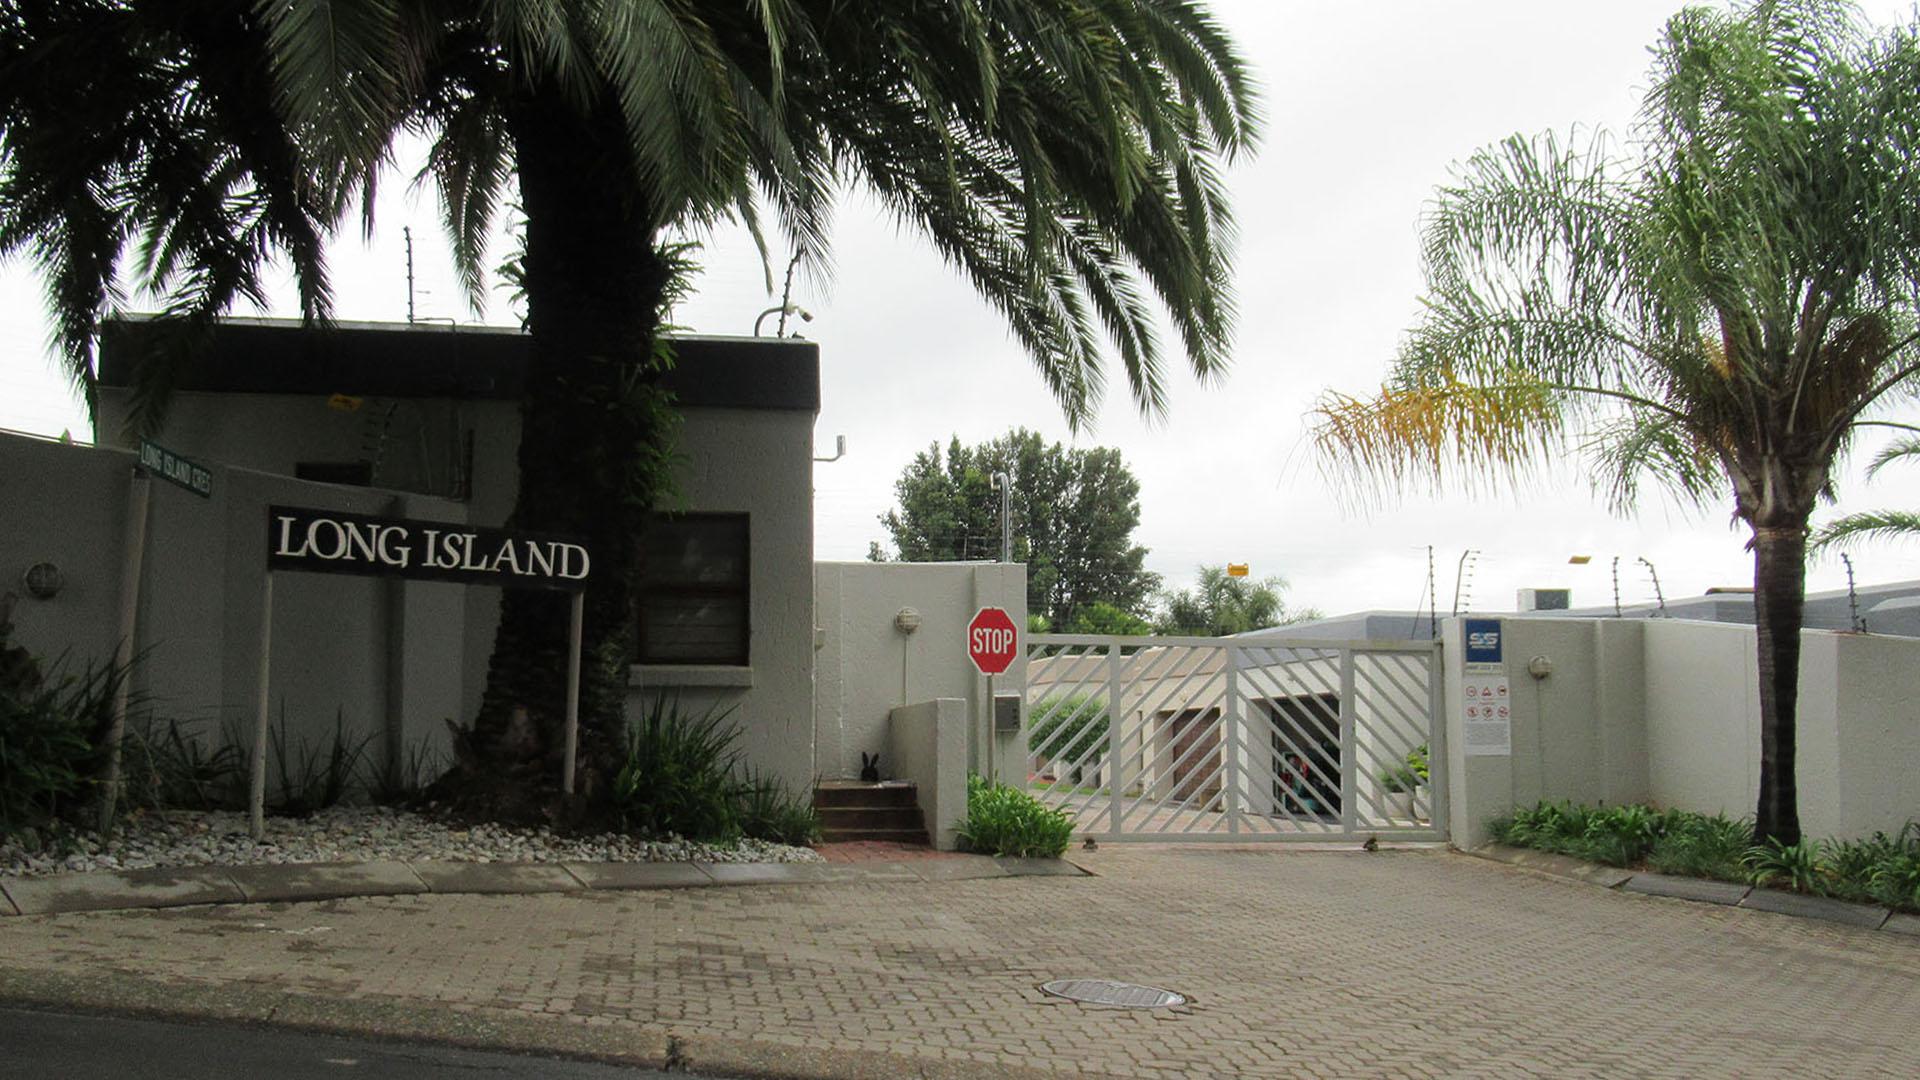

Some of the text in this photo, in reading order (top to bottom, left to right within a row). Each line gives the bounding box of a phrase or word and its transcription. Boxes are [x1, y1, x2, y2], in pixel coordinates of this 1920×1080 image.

[141, 441, 161, 472] LONG
[163, 453, 191, 485] ISLAND
[275, 516, 591, 580] LONG ISLAND
[973, 628, 1013, 654] STOP
